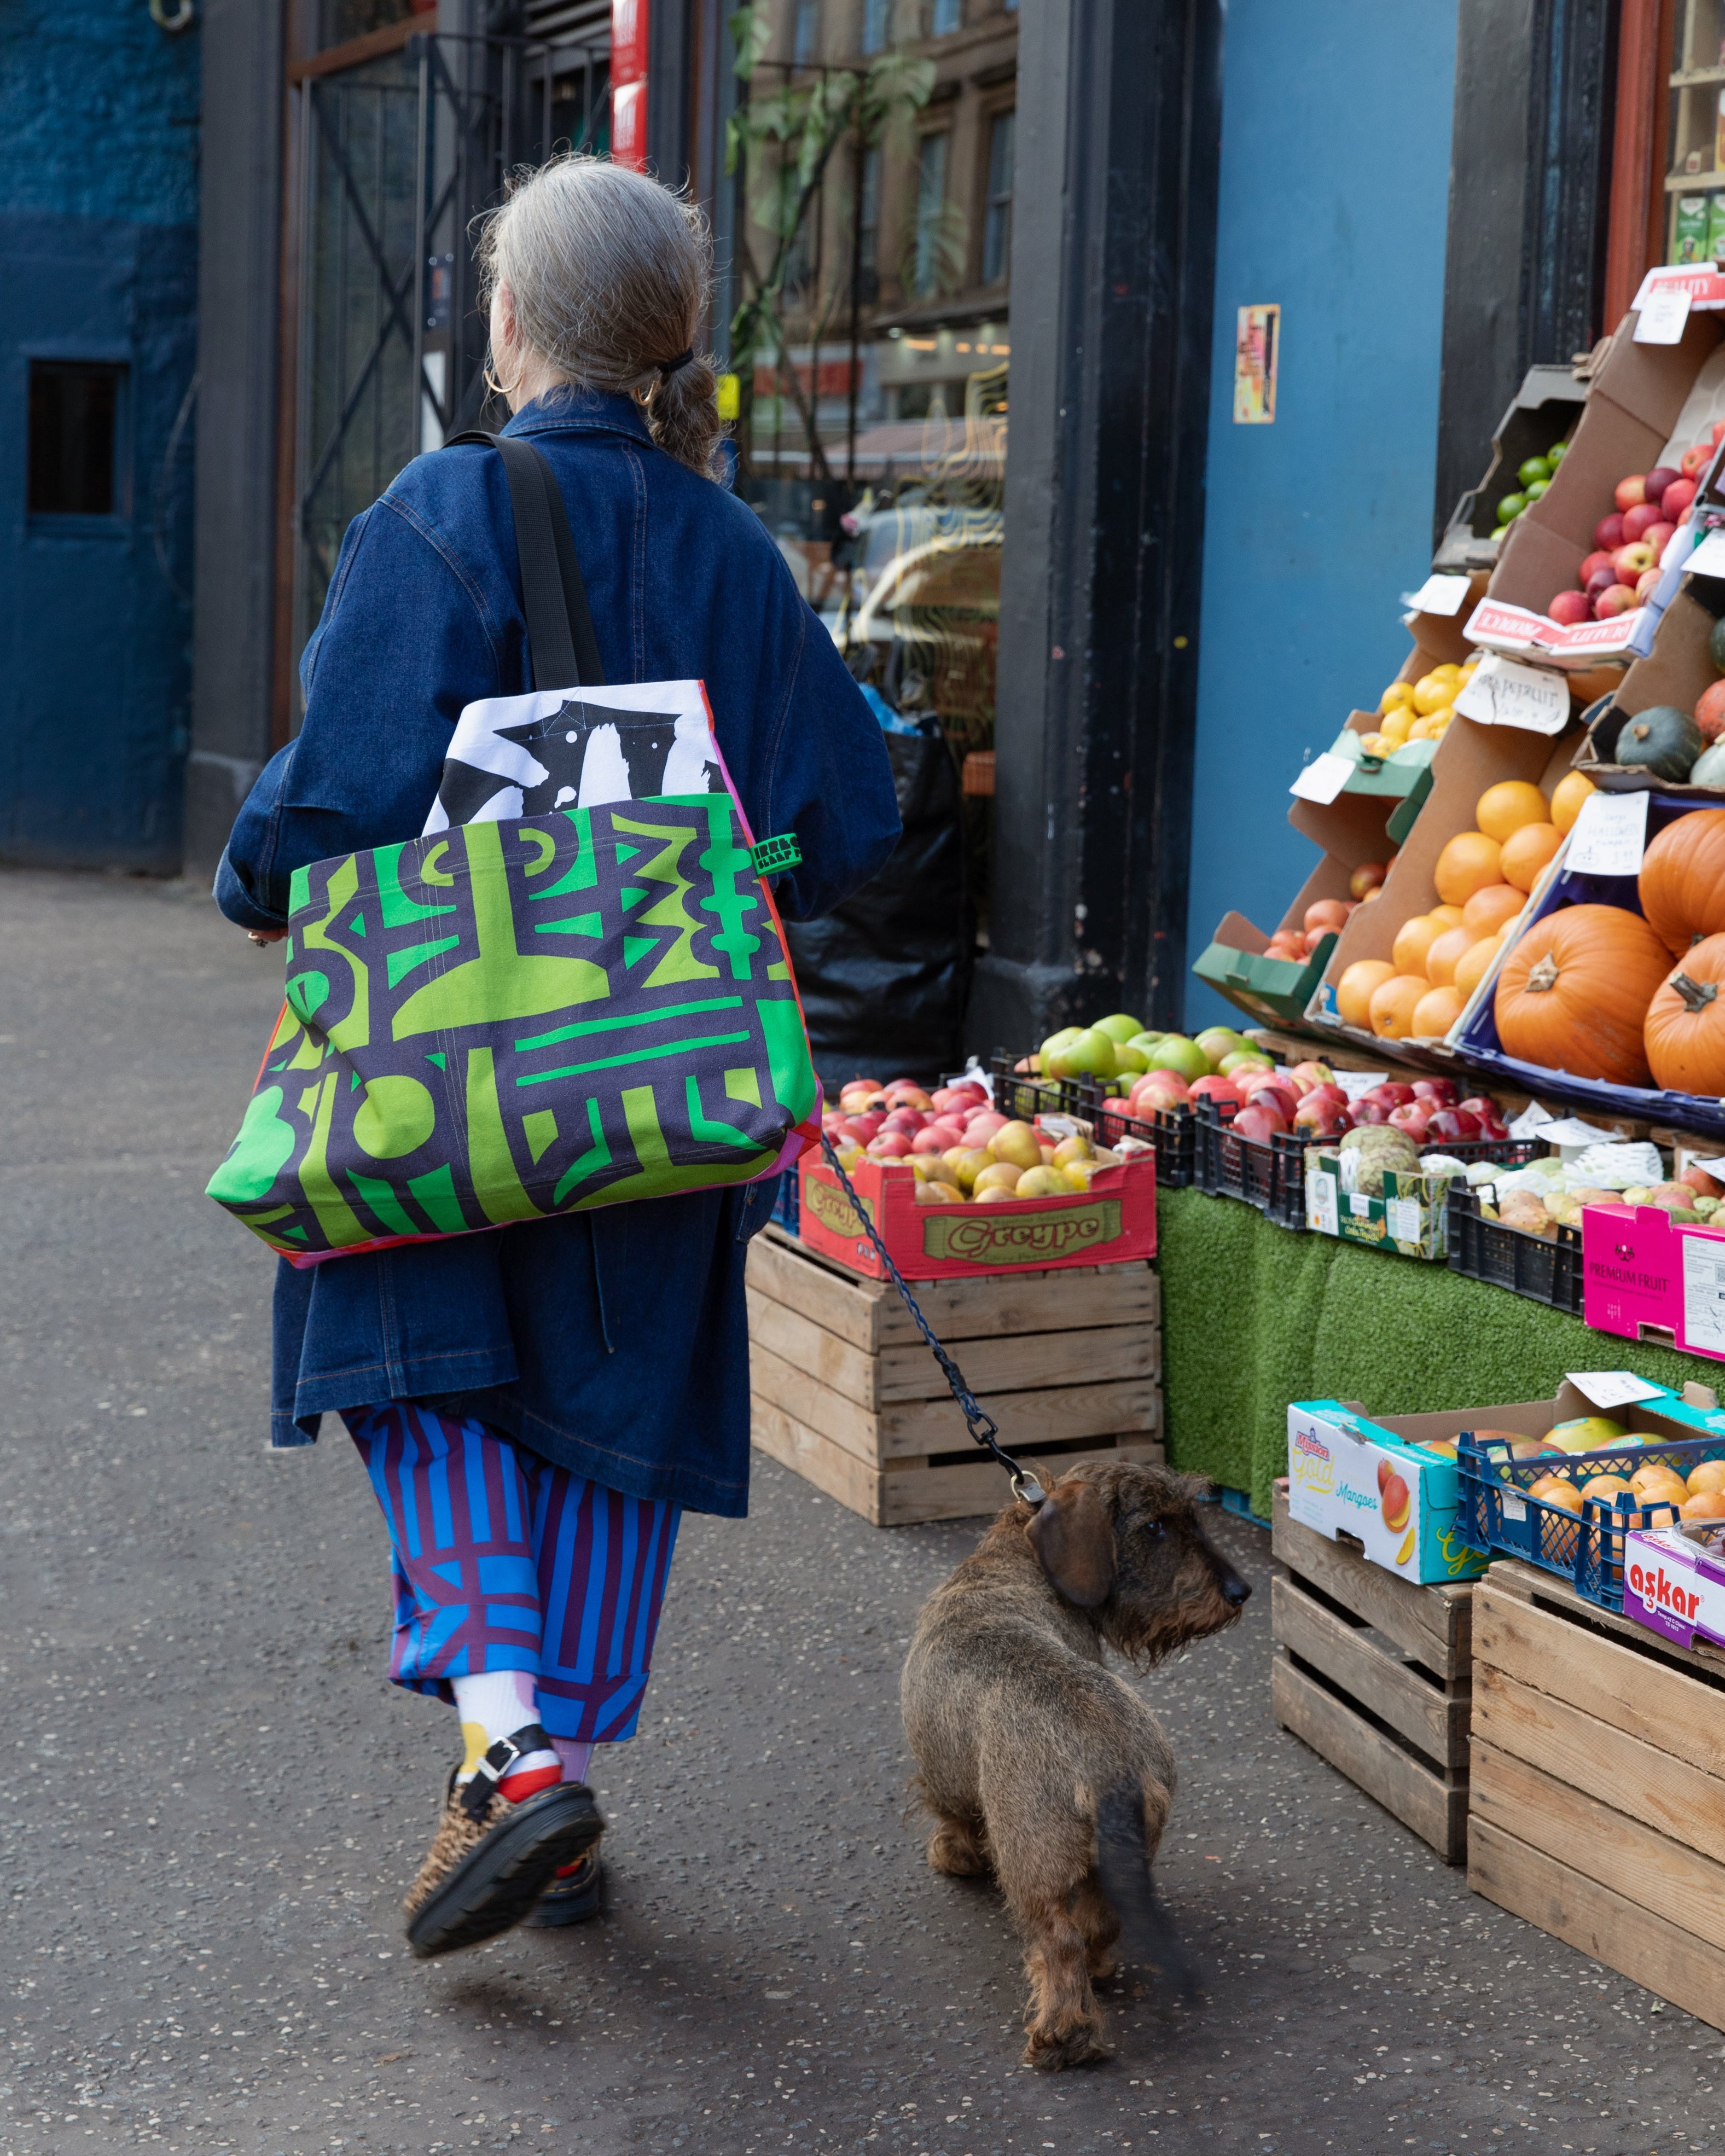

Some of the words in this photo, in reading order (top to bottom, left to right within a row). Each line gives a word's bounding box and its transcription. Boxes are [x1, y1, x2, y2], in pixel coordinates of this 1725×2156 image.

[758, 850, 792, 869] SLEEP
[812, 1182, 864, 1229] Greyp
[949, 1219, 1099, 1257] Greype
[1589, 1261, 1636, 1286] PREMIUM
[1638, 1272, 1668, 1292] FRUIT
[1297, 1433, 1329, 1458] Mission
[1292, 1445, 1335, 1486] Gold
[1336, 1480, 1378, 1509] Mangoes
